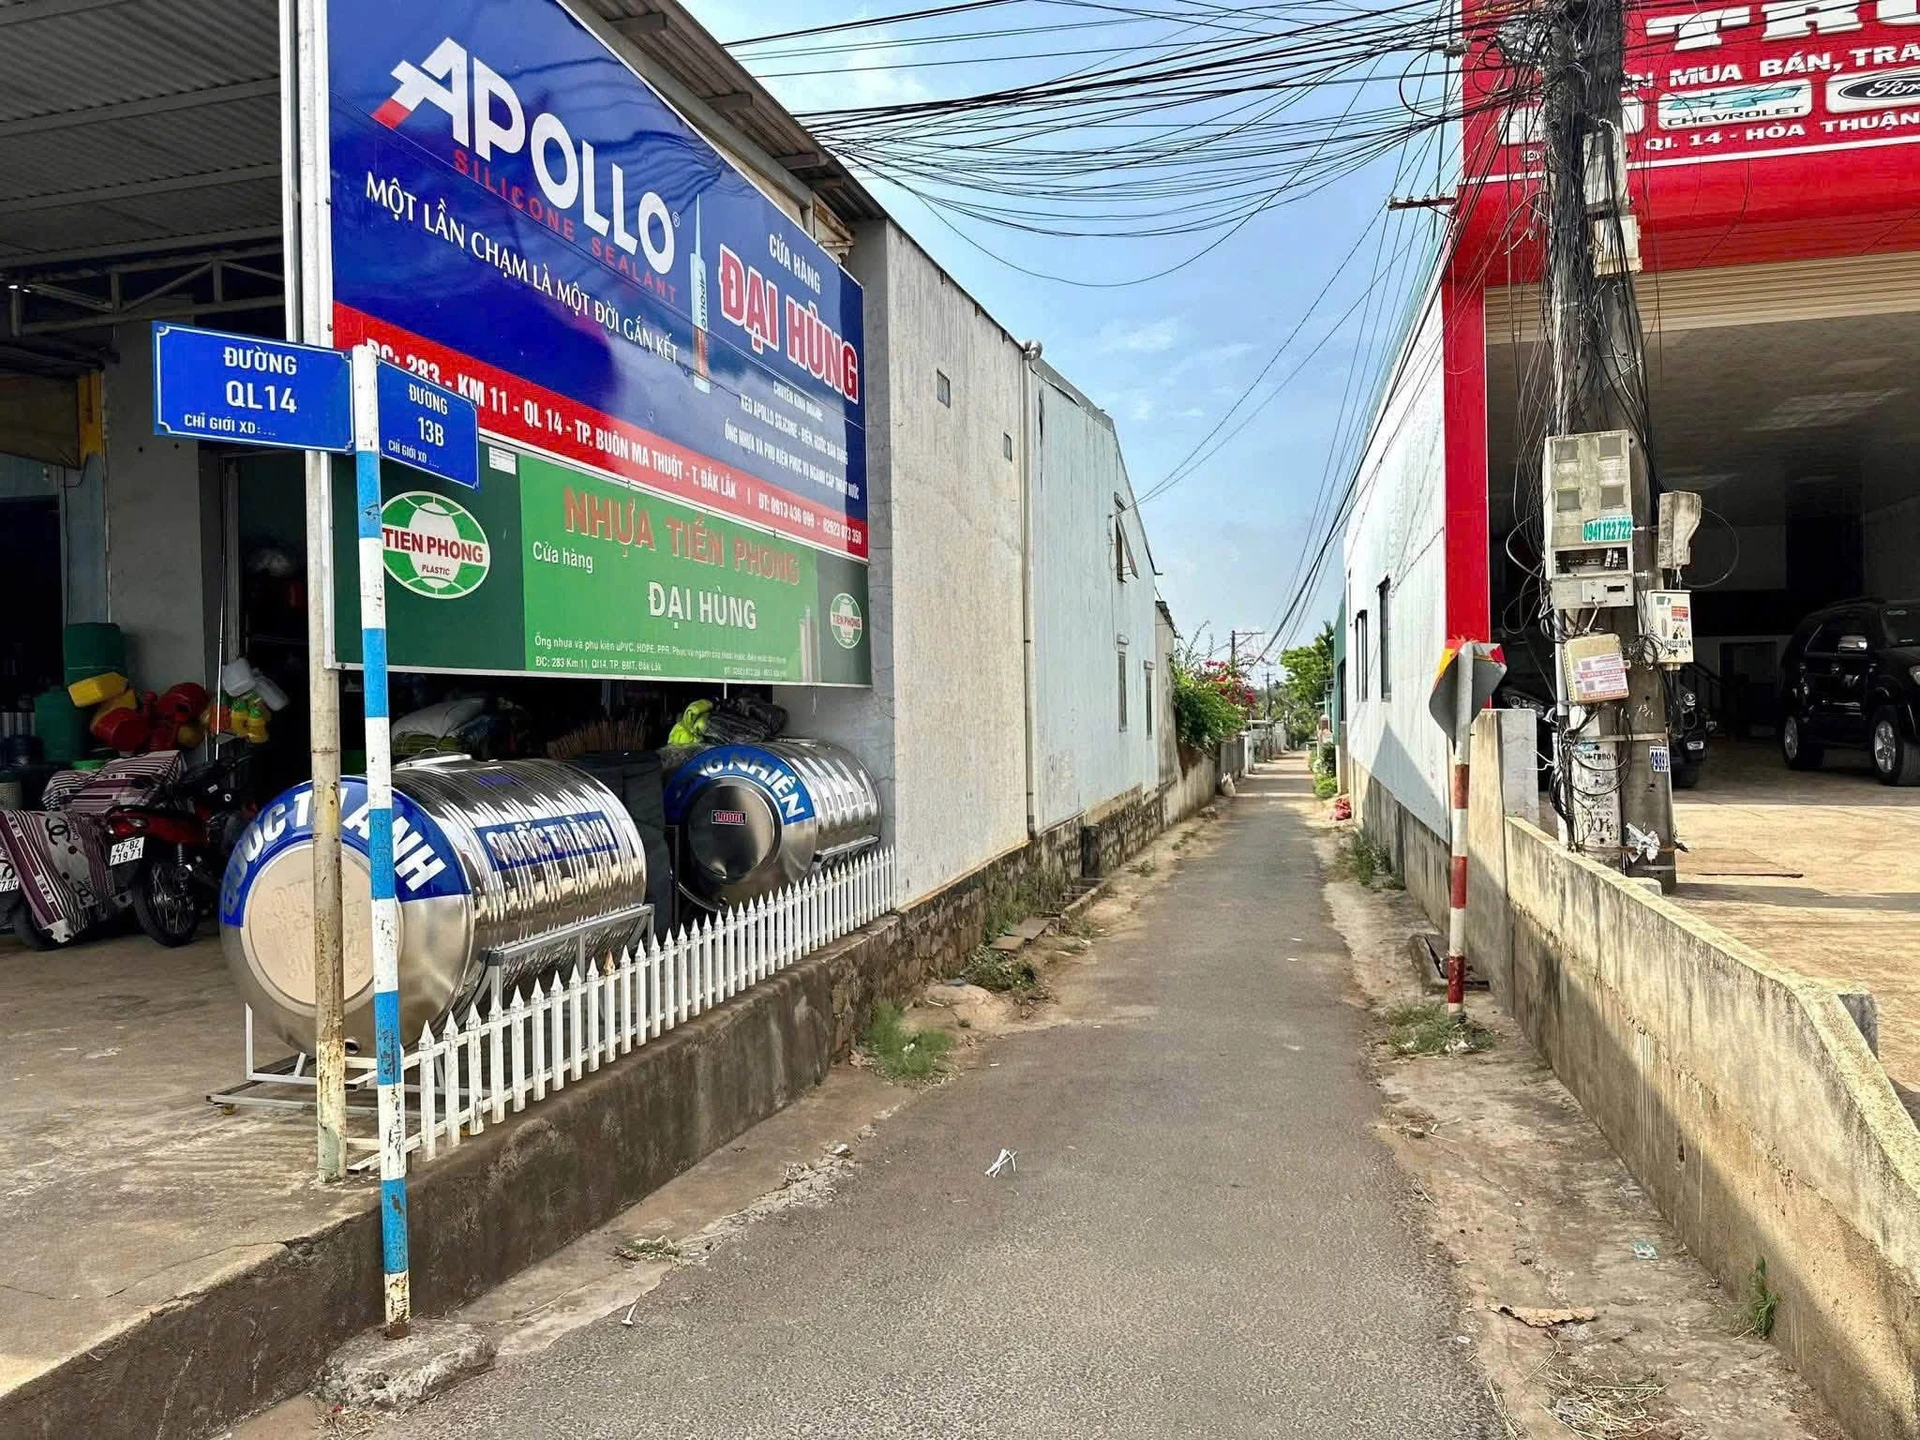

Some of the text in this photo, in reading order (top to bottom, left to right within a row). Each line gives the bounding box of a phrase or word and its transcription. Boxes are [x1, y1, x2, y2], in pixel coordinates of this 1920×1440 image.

[1669, 65, 1742, 86] MUA
[1759, 51, 1844, 77] BÁN,
[1668, 106, 1803, 126] CHEVROLET
[1689, 132, 1722, 146] 14
[1745, 123, 1806, 140] HÒA
[1820, 111, 1920, 133] THUẬN
[371, 37, 675, 275] APOLLO
[454, 149, 677, 303] SILICONE SEALANT
[366, 171, 679, 364] MỘT LẦN CHẠM LÀ MỘT ĐỜI GẮN KẾT
[769, 233, 820, 295] CỬA HÀNG
[718, 243, 858, 405] ĐẠI HÙNG
[224, 346, 297, 376] ĐƯỜNG
[225, 380, 298, 414] QL14
[408, 381, 448, 415] ĐƯỜNG
[184, 412, 206, 429] CHỈ
[209, 415, 236, 432] GIỚI
[416, 416, 445, 447] 13B
[457, 373, 485, 408] KM
[490, 386, 508, 415] 11
[524, 399, 542, 428] QL
[546, 408, 562, 435] 14
[575, 419, 593, 447] TP.
[596, 427, 628, 460] BUÔN
[632, 442, 649, 467] MA
[652, 449, 684, 482] THUỘT
[382, 527, 483, 563] TIEN PHONG
[564, 487, 800, 586] NHỰA TIẾN PHONG
[1583, 523, 1601, 541] 0941
[421, 563, 450, 576] PLASTIC
[532, 540, 594, 574] Cửa hàng
[648, 580, 757, 630] ĐẠI HÙNG
[534, 630, 551, 650] Ống
[535, 656, 550, 667] ĐC:
[551, 657, 565, 668] 283
[566, 658, 579, 668] Km
[728, 753, 806, 819] NHIÊN
